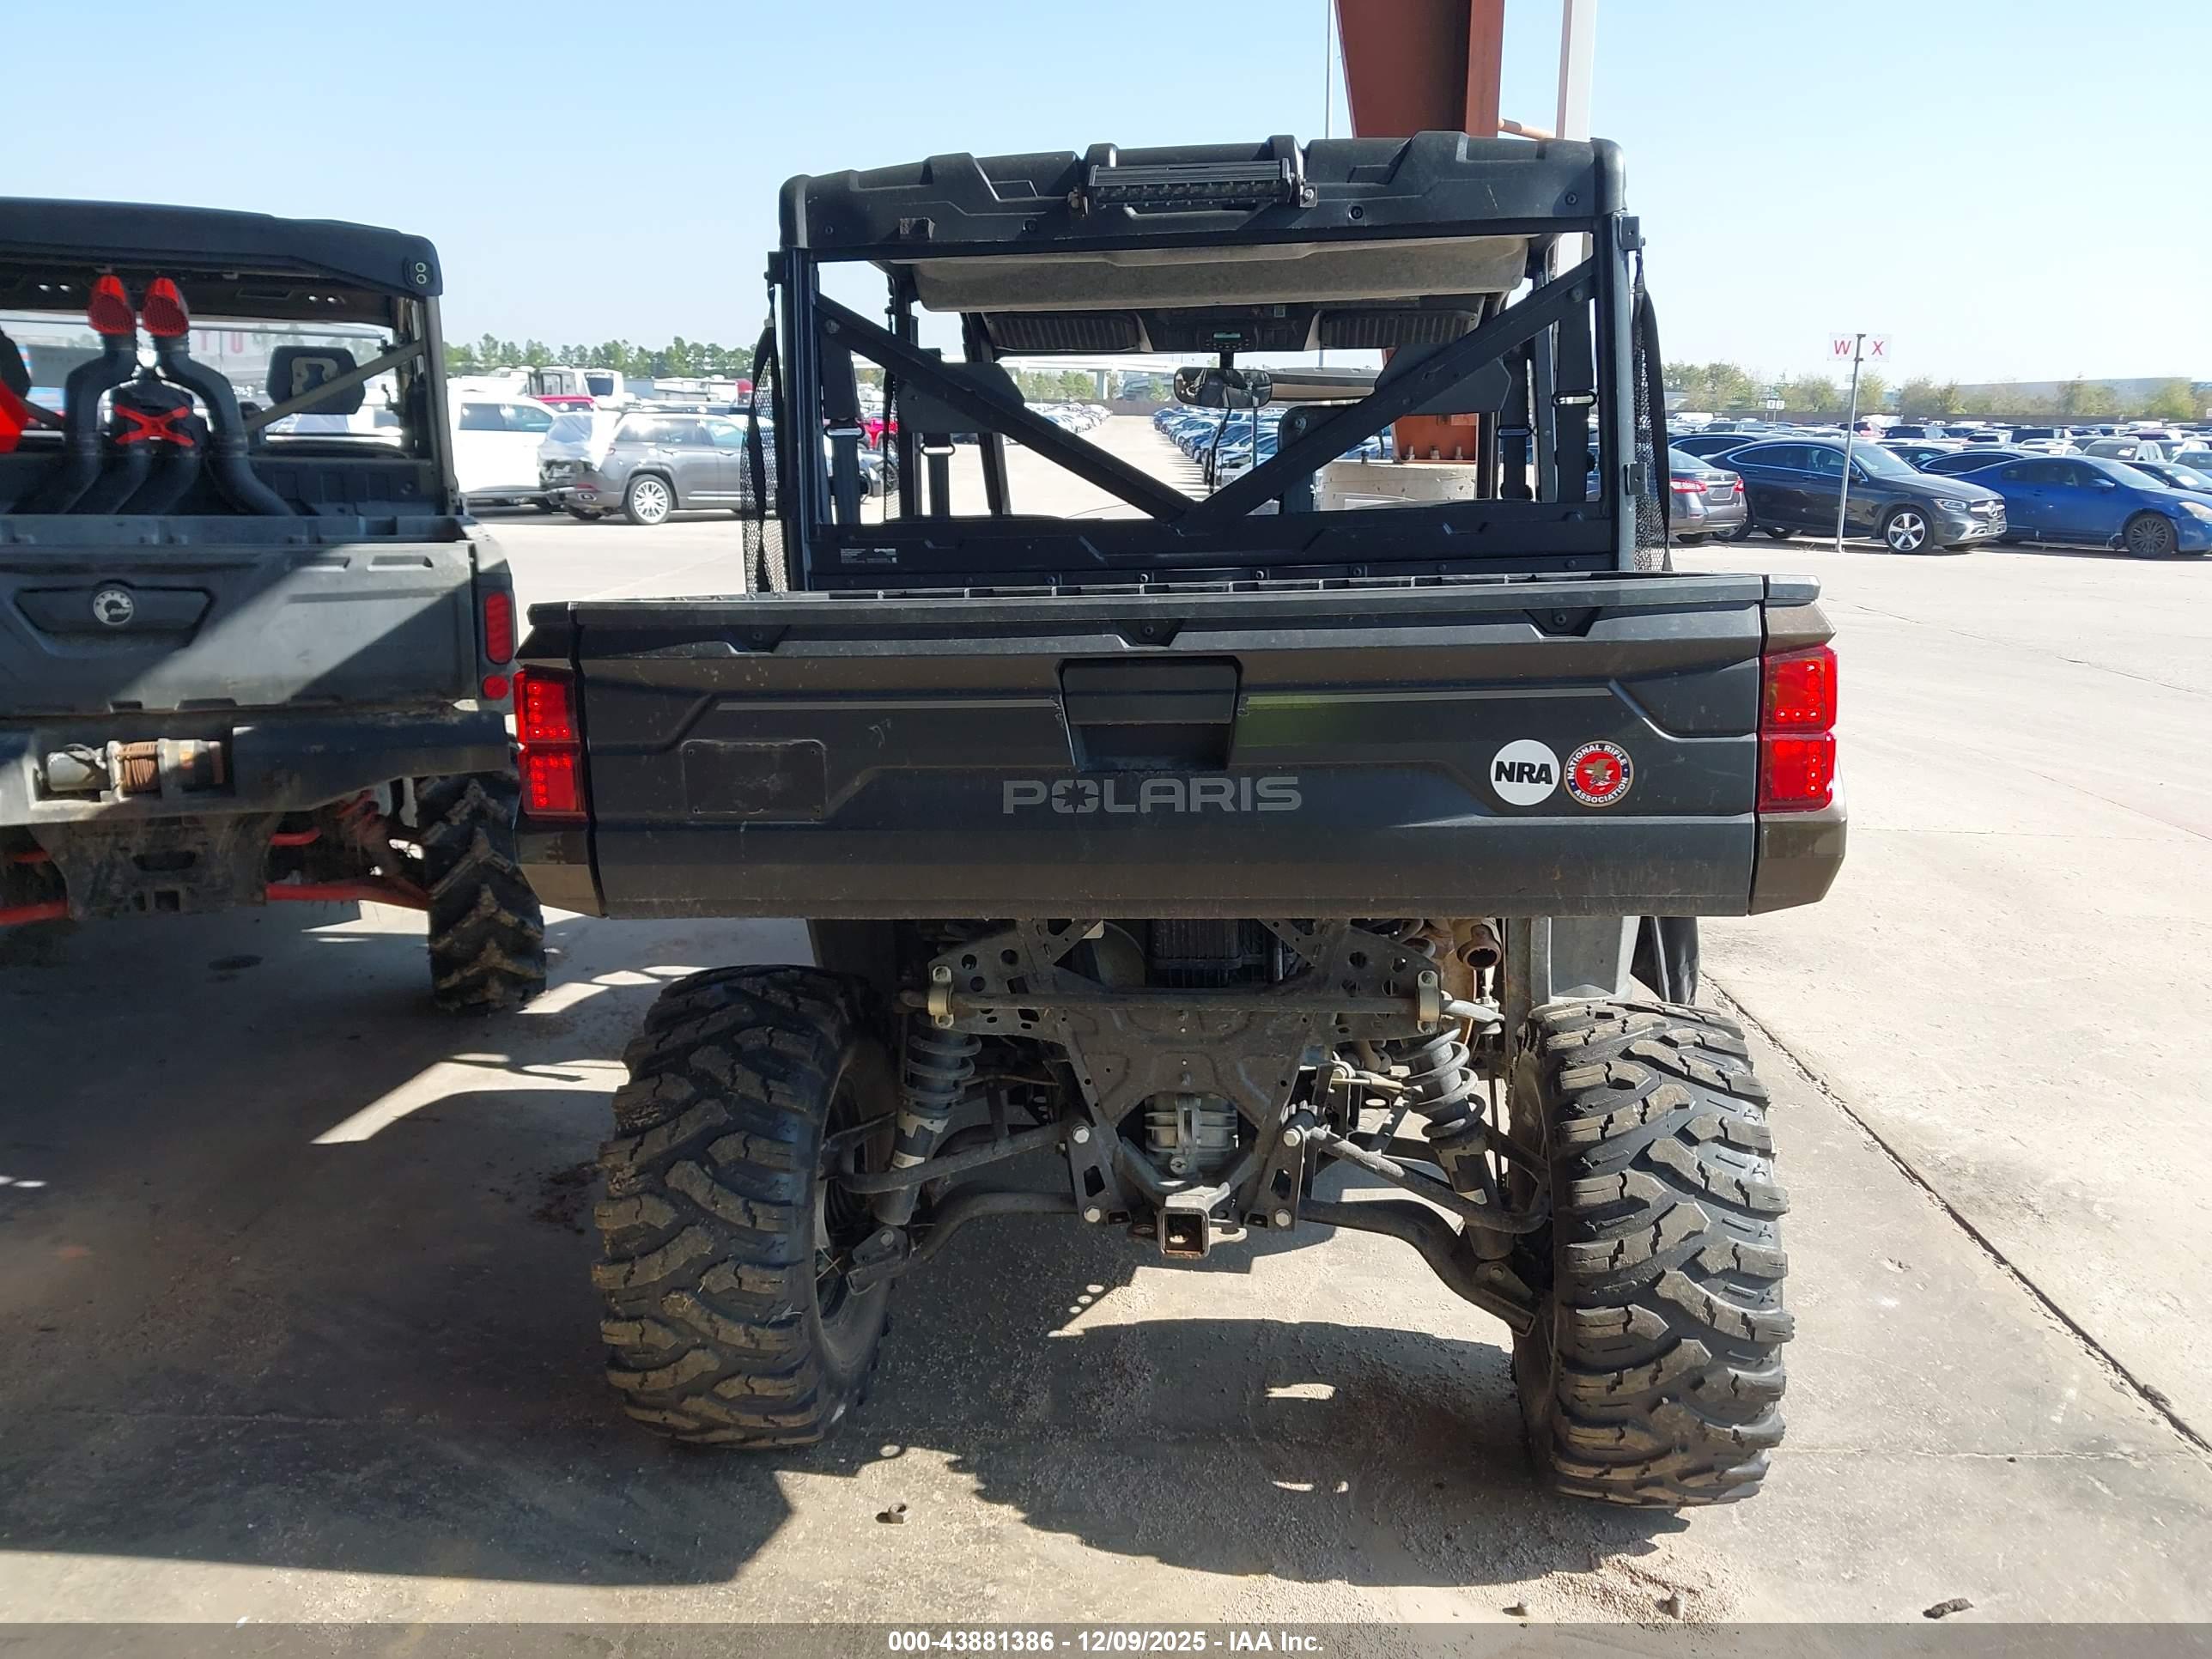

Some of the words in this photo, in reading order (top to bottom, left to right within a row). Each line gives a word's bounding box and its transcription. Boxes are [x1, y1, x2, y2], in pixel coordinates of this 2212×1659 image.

[1834, 340, 1851, 355] W
[1872, 341, 1884, 356] X
[1495, 761, 1553, 785] NRA
[1567, 744, 1601, 780] NATIONAL
[1604, 744, 1627, 766] RIFLE
[1003, 776, 1302, 814] POLARIS
[1573, 776, 1628, 803] ASSOCIATION
